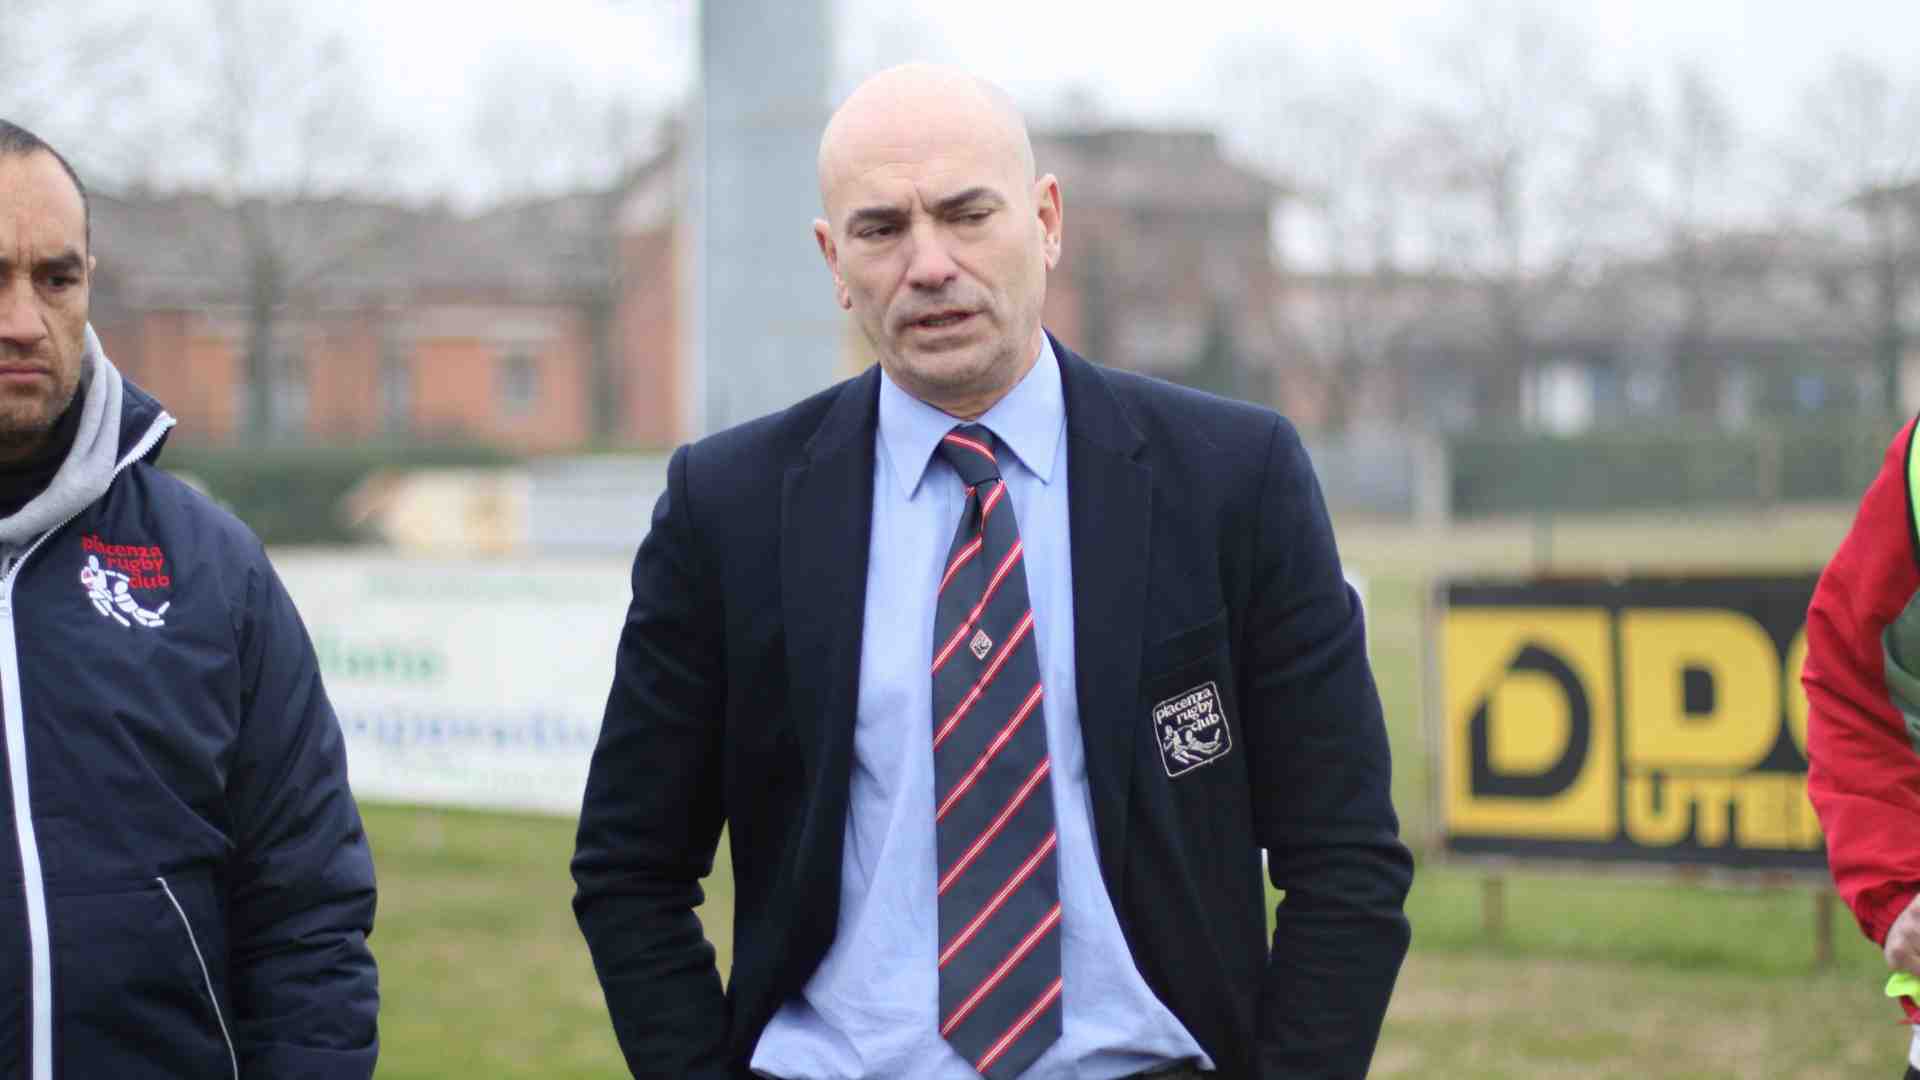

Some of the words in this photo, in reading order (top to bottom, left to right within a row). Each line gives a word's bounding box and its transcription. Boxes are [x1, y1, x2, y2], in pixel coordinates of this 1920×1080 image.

[82, 533, 161, 556] piacenza
[107, 553, 164, 577] rugby
[129, 572, 170, 590] club
[1623, 609, 1808, 770] D
[1156, 688, 1213, 725] piacenza
[1176, 699, 1213, 724] rugby
[1191, 713, 1219, 731] club
